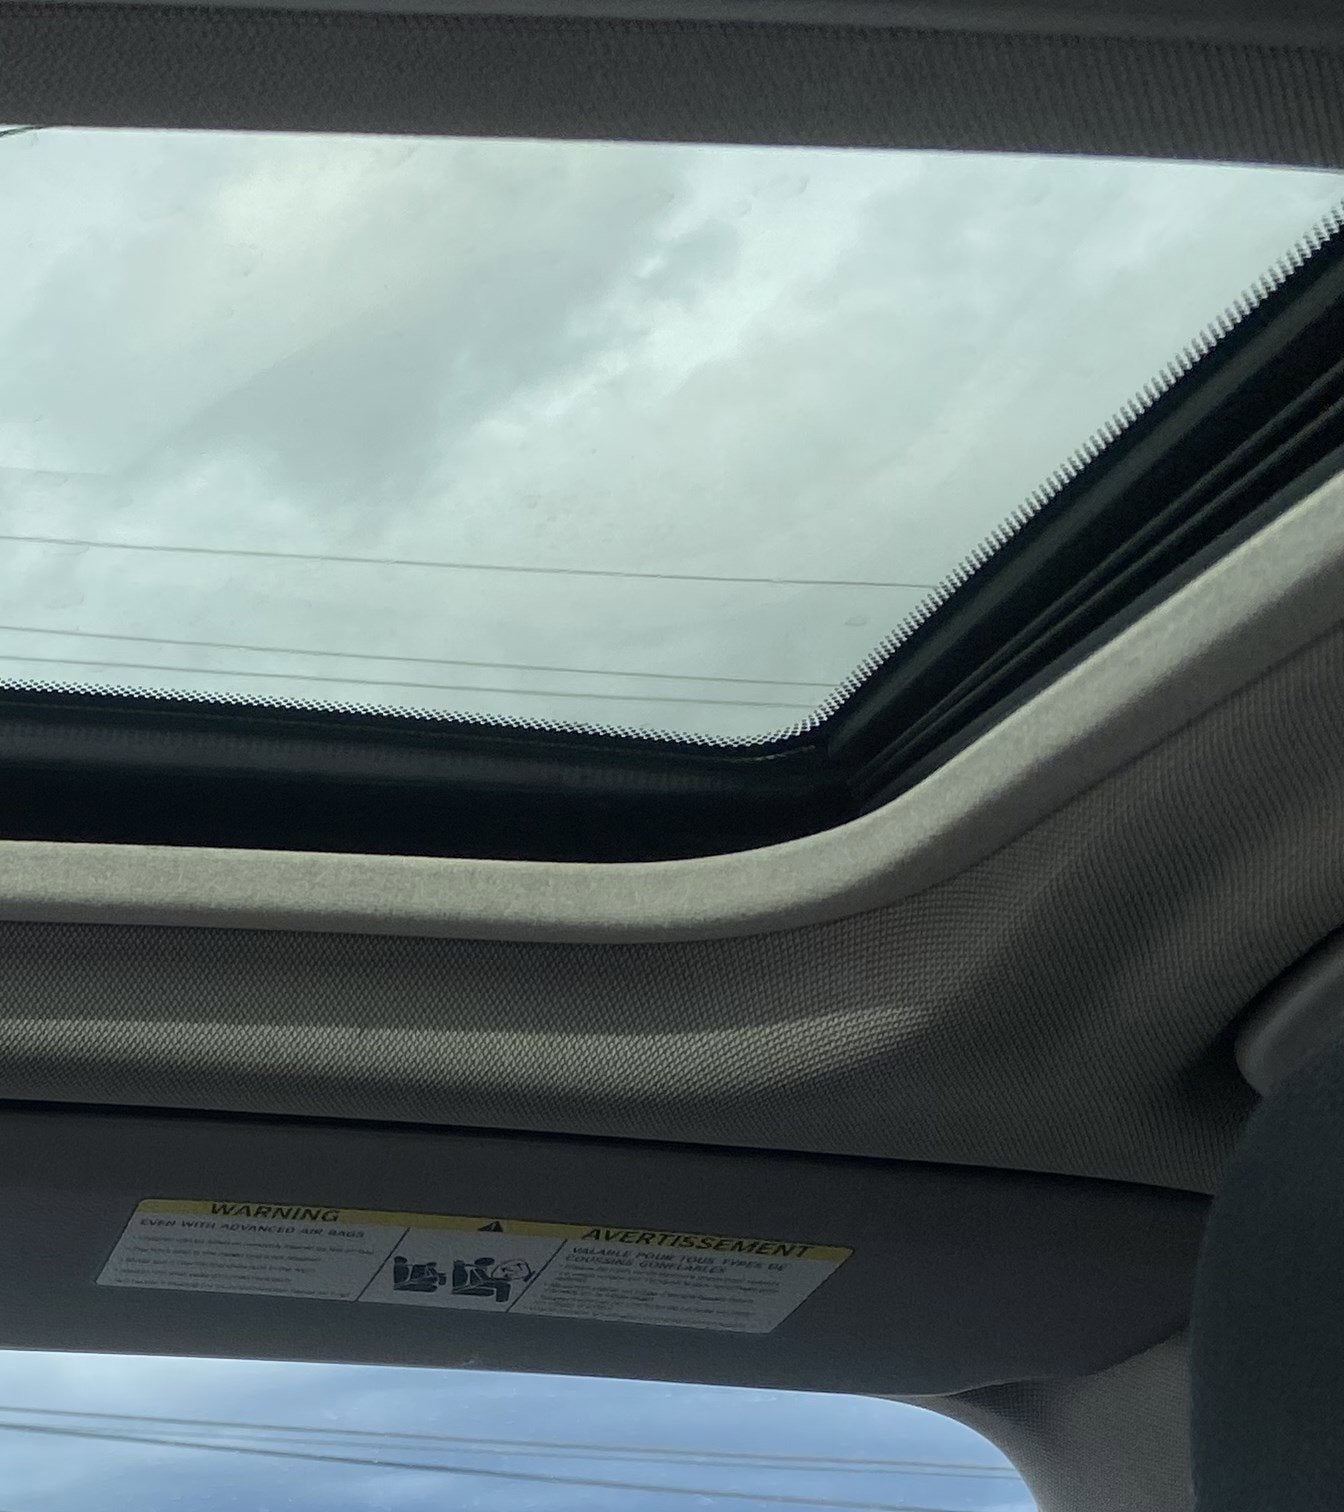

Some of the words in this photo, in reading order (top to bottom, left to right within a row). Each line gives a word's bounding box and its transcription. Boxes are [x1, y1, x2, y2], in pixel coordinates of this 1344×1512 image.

[211, 1203, 340, 1222] WARNING
[140, 1218, 176, 1227] EVEN
[181, 1220, 215, 1229] WITH
[220, 1222, 296, 1234] ADVANCED
[300, 1228, 323, 1236] AIR
[327, 1228, 365, 1238] BAGS
[582, 1228, 816, 1257] AVERTISSEMENT
